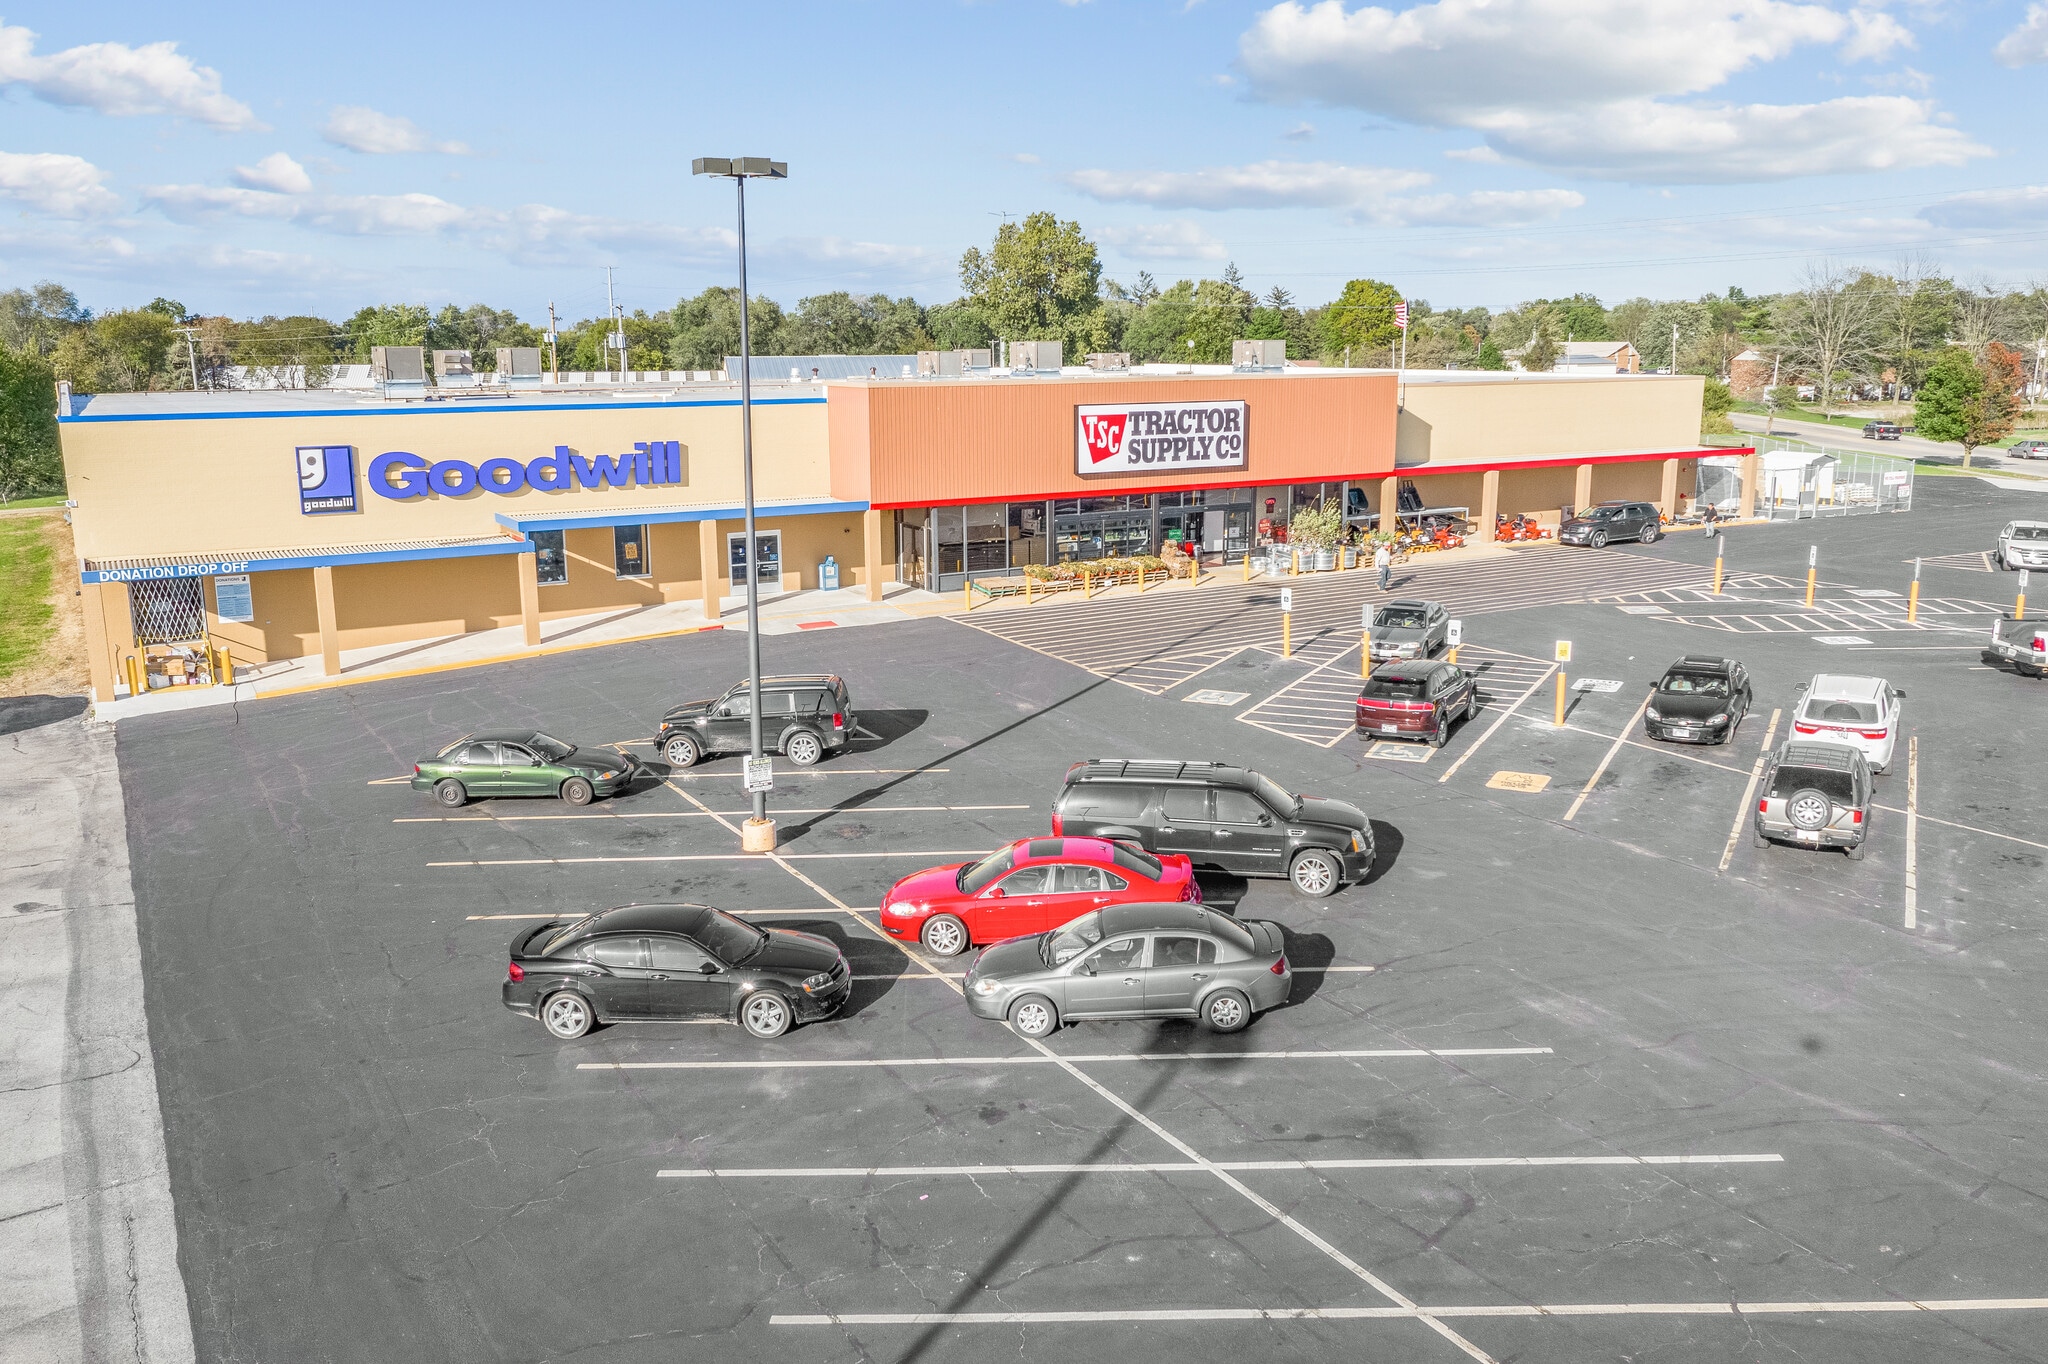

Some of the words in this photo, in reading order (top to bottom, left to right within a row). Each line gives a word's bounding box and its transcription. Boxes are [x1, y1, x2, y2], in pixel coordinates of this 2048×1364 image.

[1086, 416, 1120, 453] TSC
[1128, 408, 1241, 436] TRACTOR
[1128, 436, 1214, 464] SUPPLY
[368, 441, 681, 498] Goodwill
[304, 497, 354, 512] goodwill
[99, 566, 174, 582] DONATION
[178, 563, 218, 577] DROP
[221, 561, 249, 573] OFF
